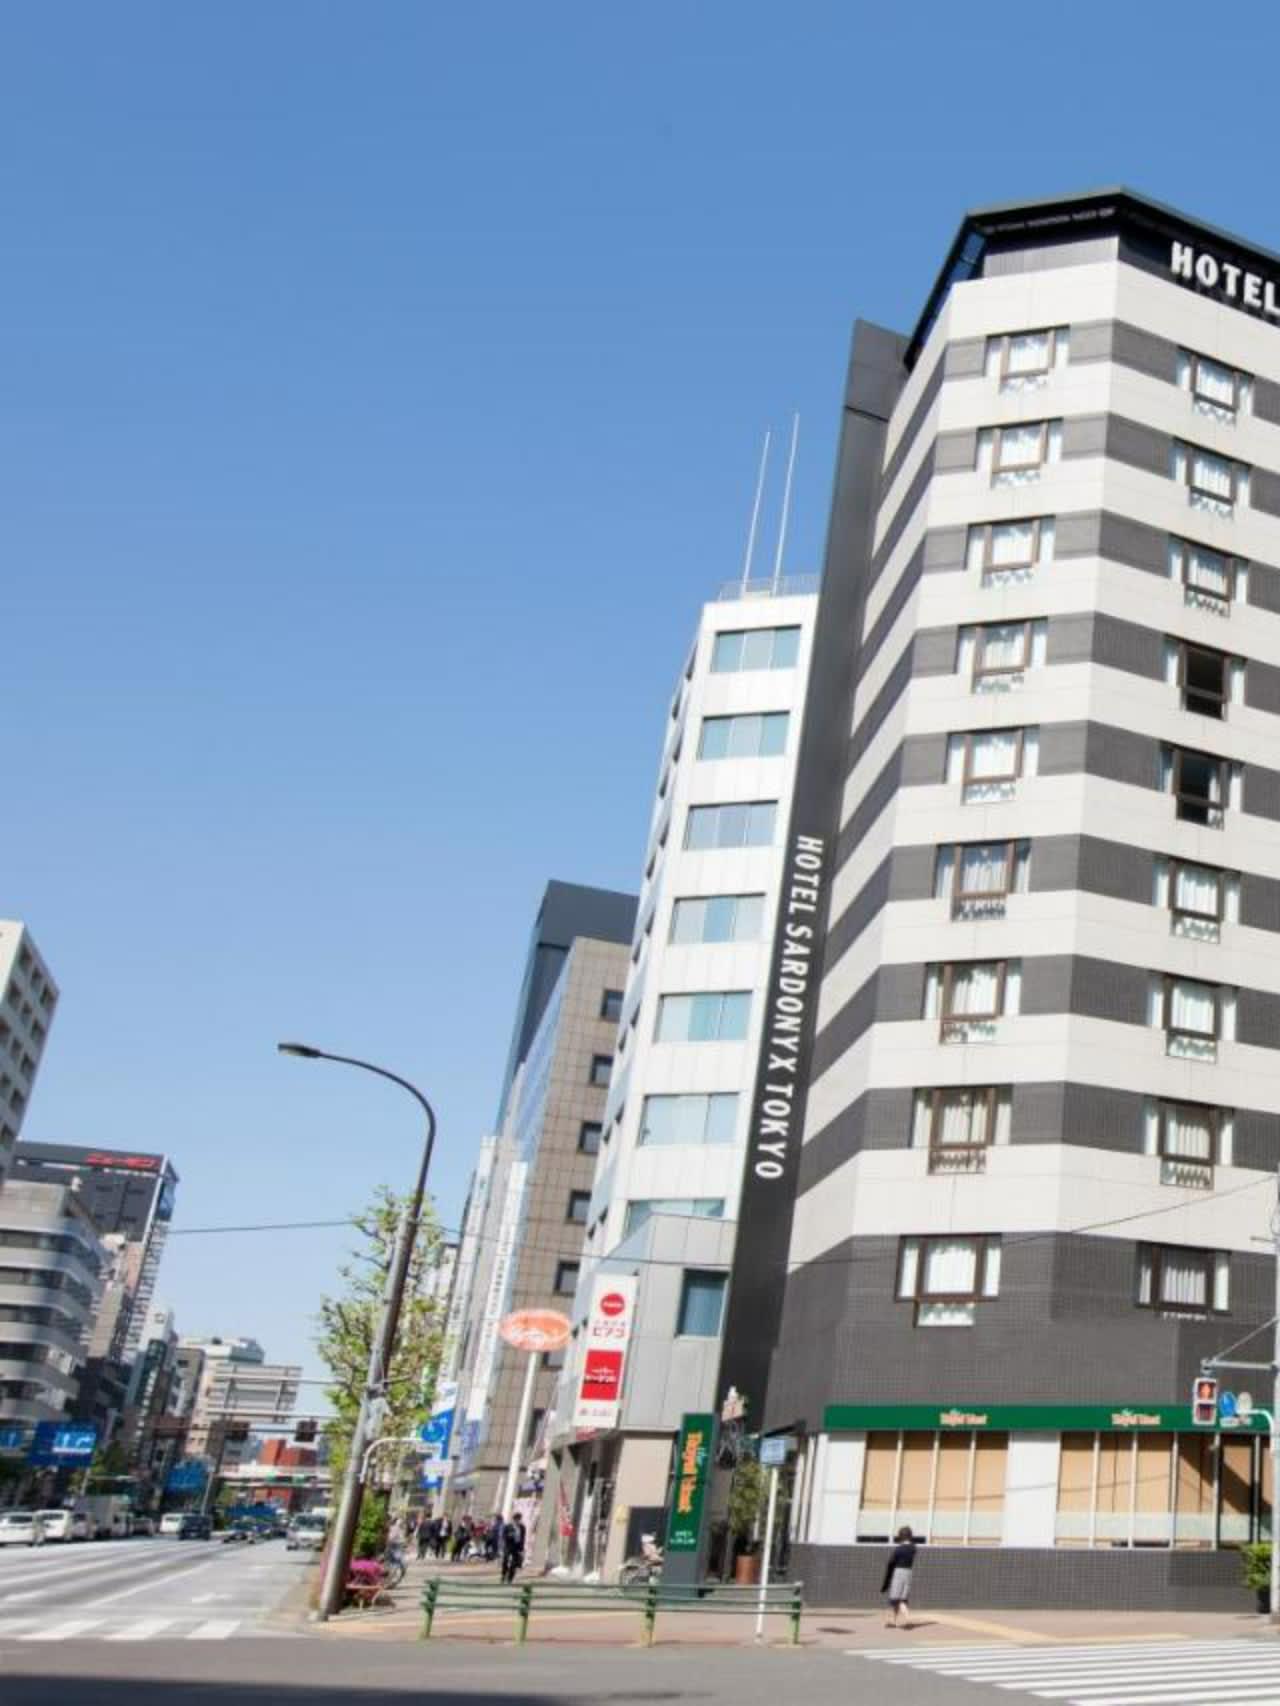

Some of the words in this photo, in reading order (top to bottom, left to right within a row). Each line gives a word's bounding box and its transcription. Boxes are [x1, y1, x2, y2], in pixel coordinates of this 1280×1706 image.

[786, 835, 824, 916] HOTEL
[767, 923, 813, 1074] SARDONYX
[755, 1084, 794, 1180] TOKYO
